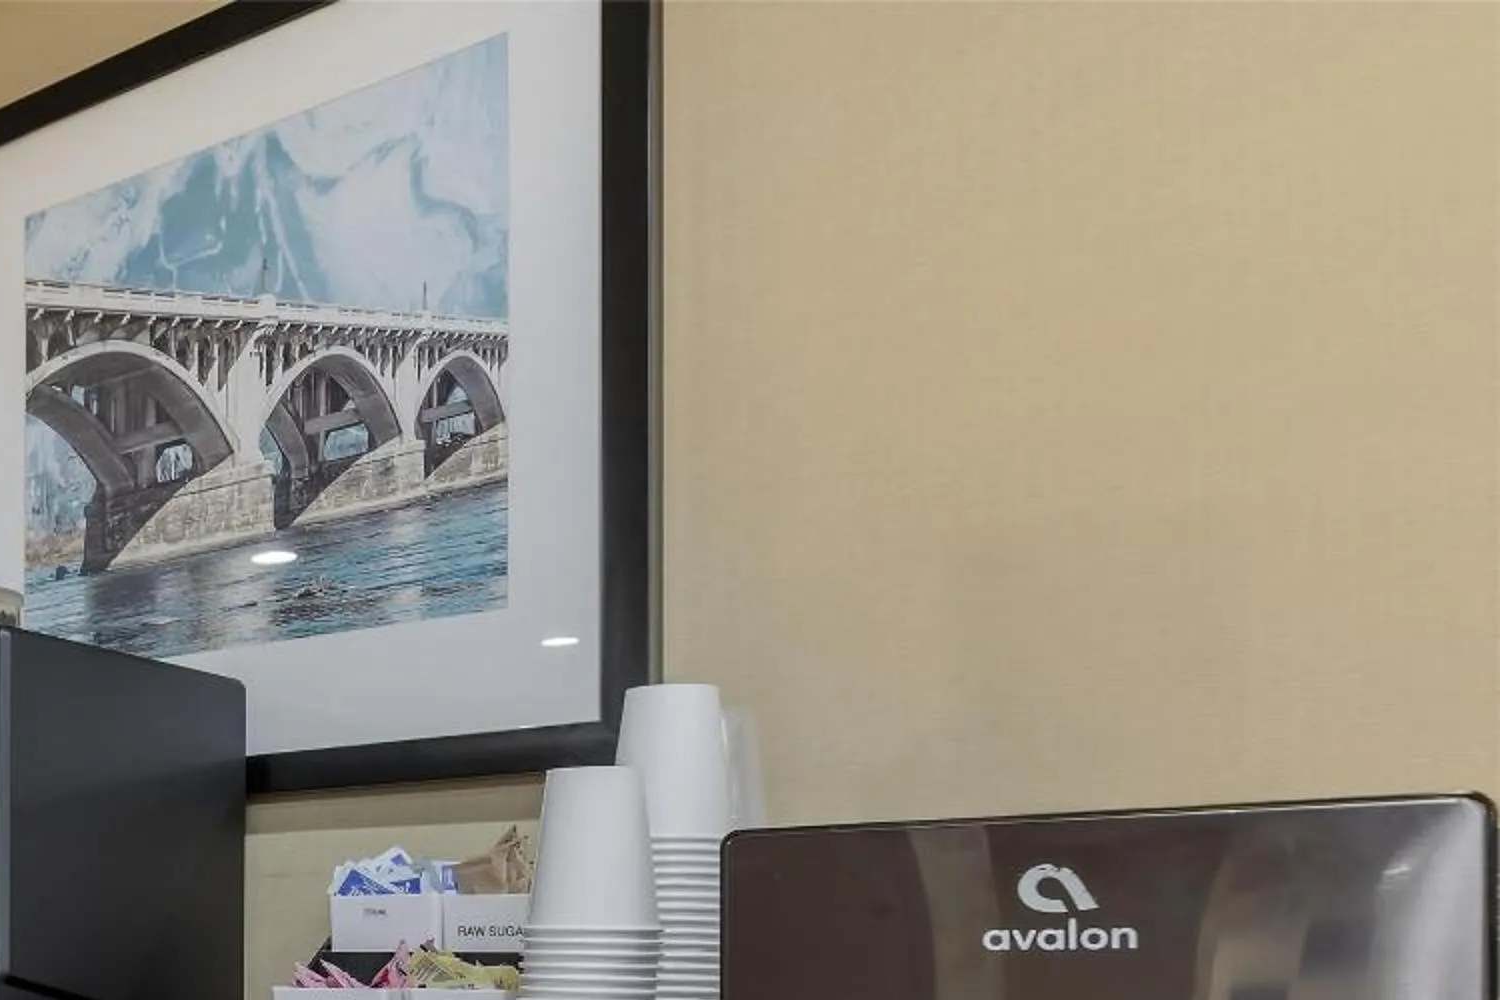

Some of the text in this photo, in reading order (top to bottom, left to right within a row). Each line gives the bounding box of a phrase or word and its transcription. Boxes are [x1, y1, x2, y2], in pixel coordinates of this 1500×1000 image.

[457, 925, 526, 938] RAW SUGA
[982, 917, 1139, 951] avalon
